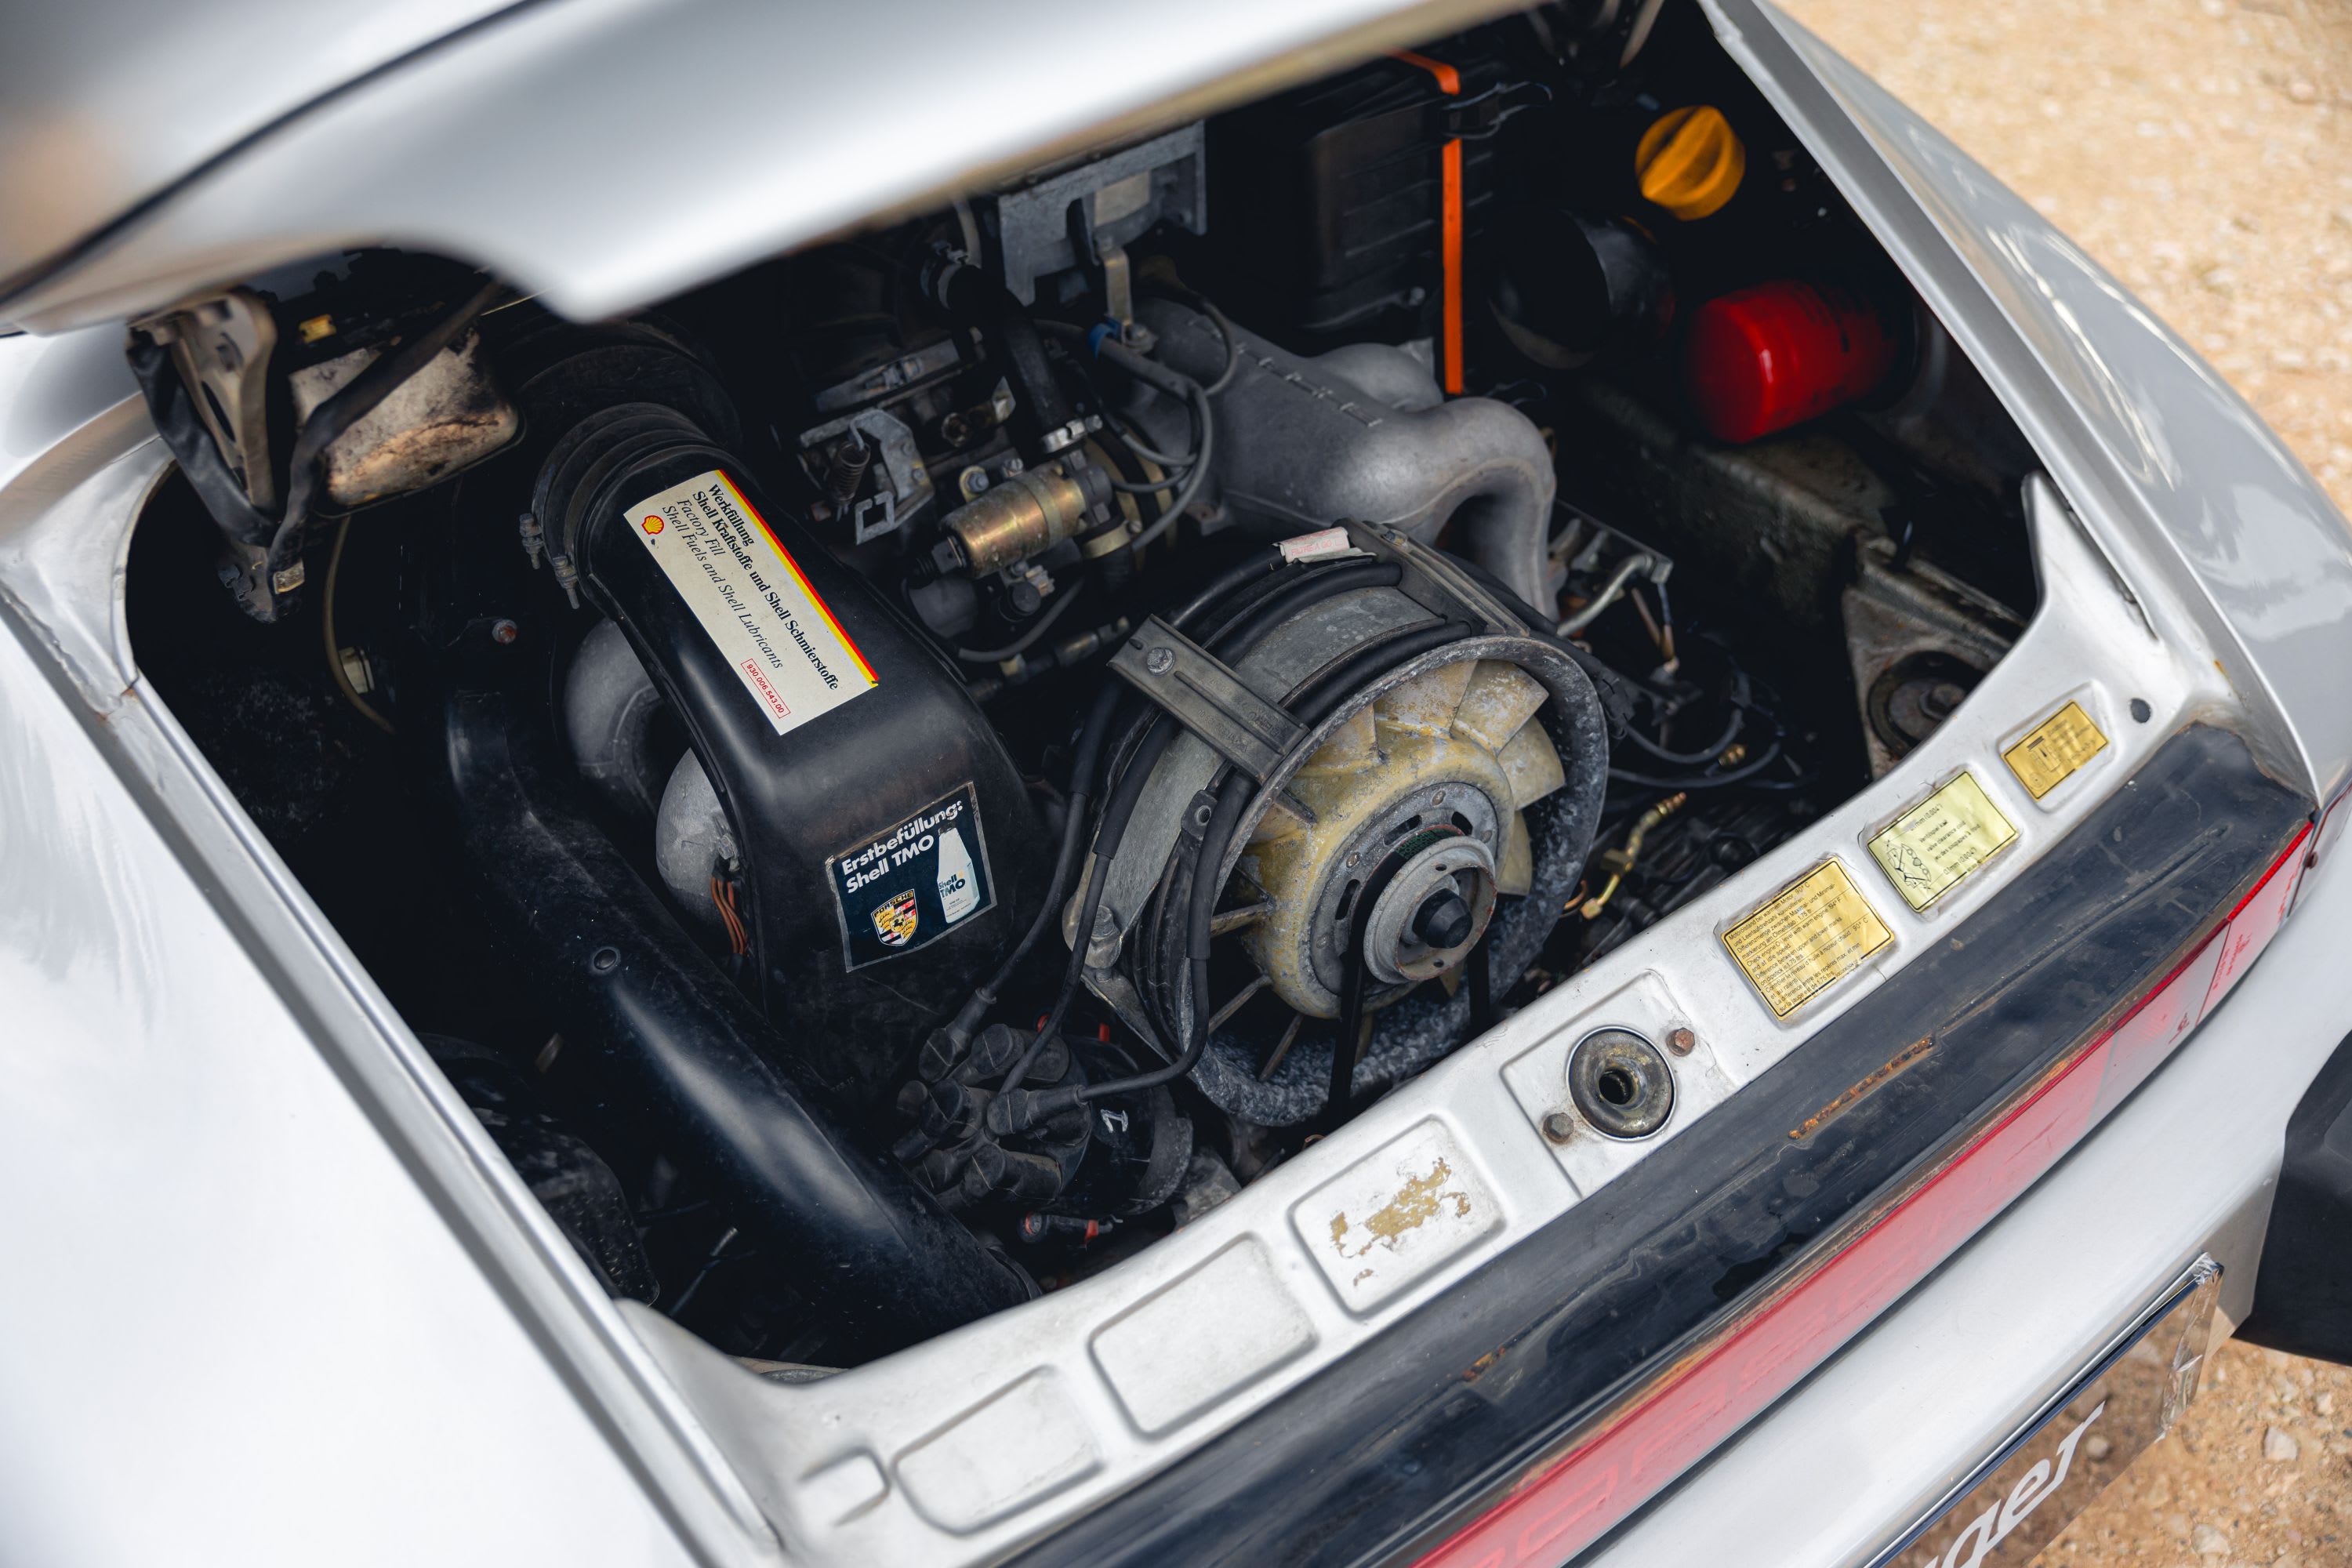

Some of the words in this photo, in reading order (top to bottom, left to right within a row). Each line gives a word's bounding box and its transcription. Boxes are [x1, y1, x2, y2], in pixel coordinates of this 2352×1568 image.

[677, 499, 708, 539] Factory
[704, 533, 726, 555] Fill
[708, 484, 754, 546] Werkfüllung
[662, 506, 688, 533] Shell
[683, 532, 707, 562] Fuels
[702, 562, 725, 583] and
[718, 584, 745, 612] Shell
[739, 613, 783, 669] Lubricants
[692, 492, 717, 520] Shell
[713, 520, 753, 570] Kraftstoffe
[750, 571, 768, 593] und
[764, 592, 792, 621] Shell
[785, 620, 838, 690] Schmierstoffe
[746, 663, 785, 713] 930.006.543.00
[842, 800, 964, 876] Erstbefüllung:
[847, 859, 889, 894] Shell
[891, 835, 935, 867] TMO
[938, 874, 957, 889] Shell
[940, 878, 966, 898] TMO
[874, 891, 913, 917] PORSCHE
[1737, 927, 1771, 954] Differenzmenge
[1769, 913, 1790, 930] zwischen
[1808, 895, 1818, 903] und
[1733, 938, 1742, 947] und
[1740, 940, 1767, 960] markierung
[1746, 954, 1761, 967] Check
[1761, 945, 1777, 957] engine
[1792, 926, 1802, 935] with
[1802, 918, 1814, 928] warm
[1751, 964, 1761, 972] and
[1755, 960, 1778, 979] Difference
[1766, 967, 1784, 982] dipstick
[1791, 992, 1805, 1004] jauge
[1924, 1400, 2107, 1568] ger
